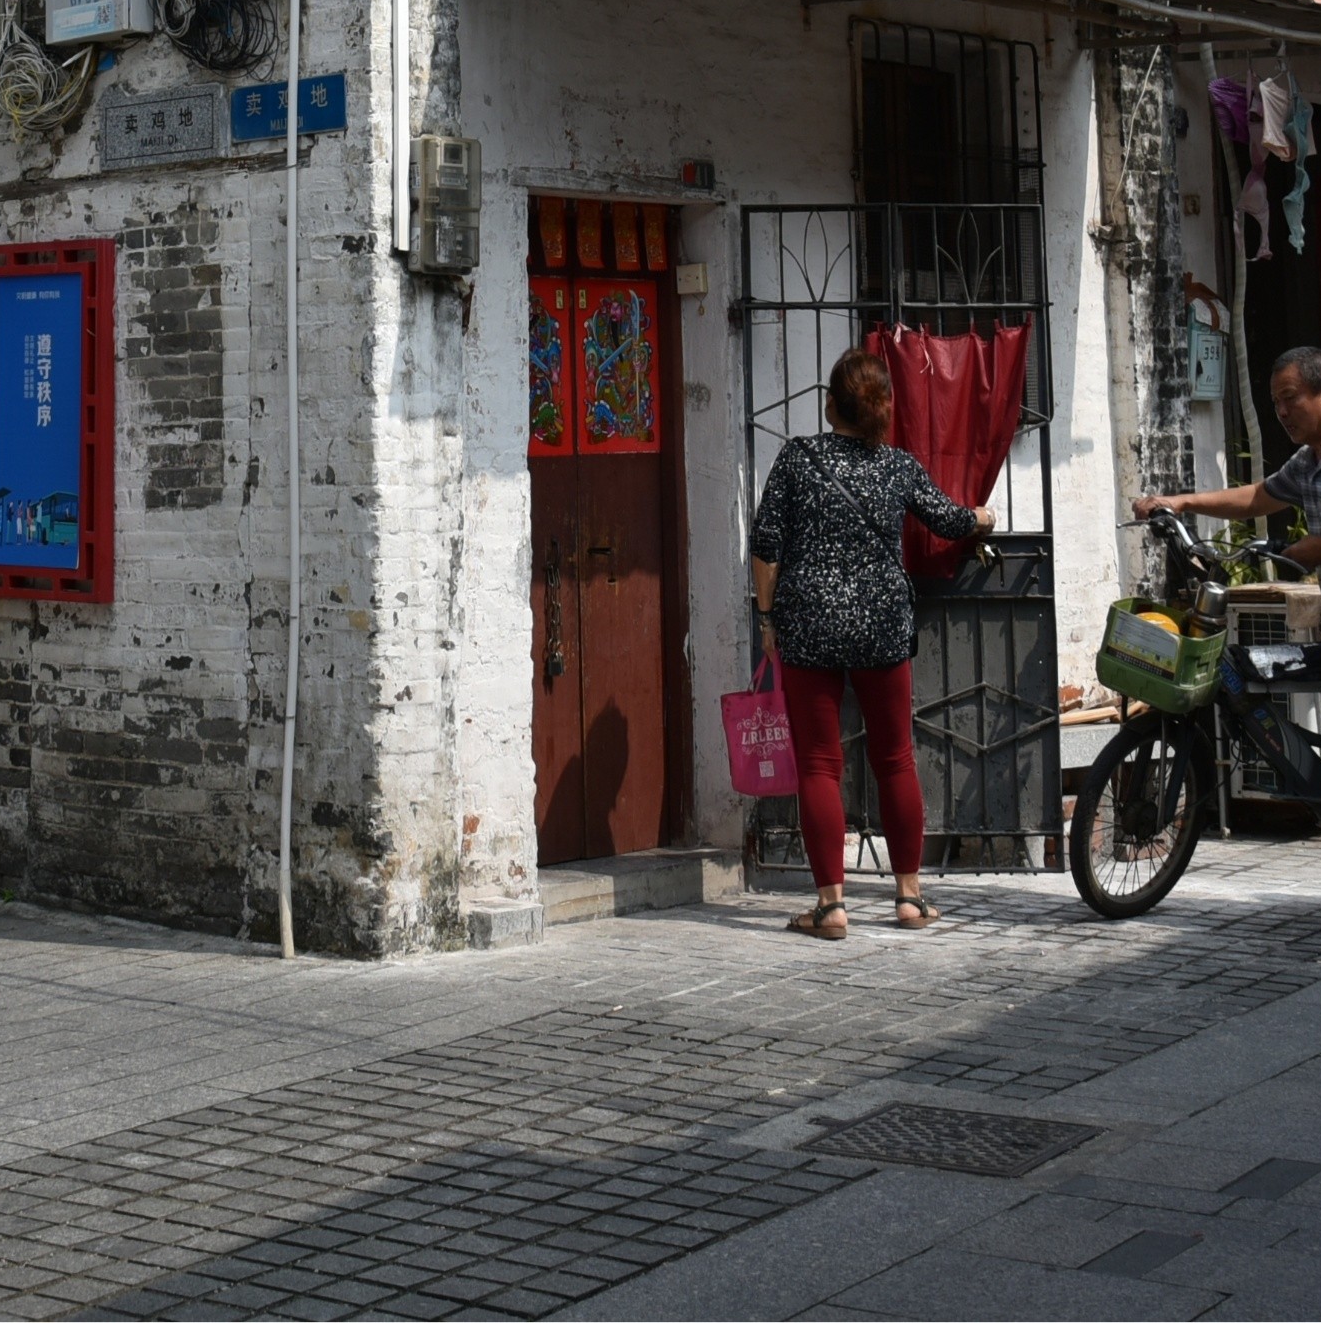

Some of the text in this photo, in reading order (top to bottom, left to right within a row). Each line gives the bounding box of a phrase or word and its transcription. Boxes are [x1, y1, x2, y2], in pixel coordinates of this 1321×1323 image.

[124, 106, 194, 135] 卖鸡地
[37, 334, 52, 427] 遵守秩序
